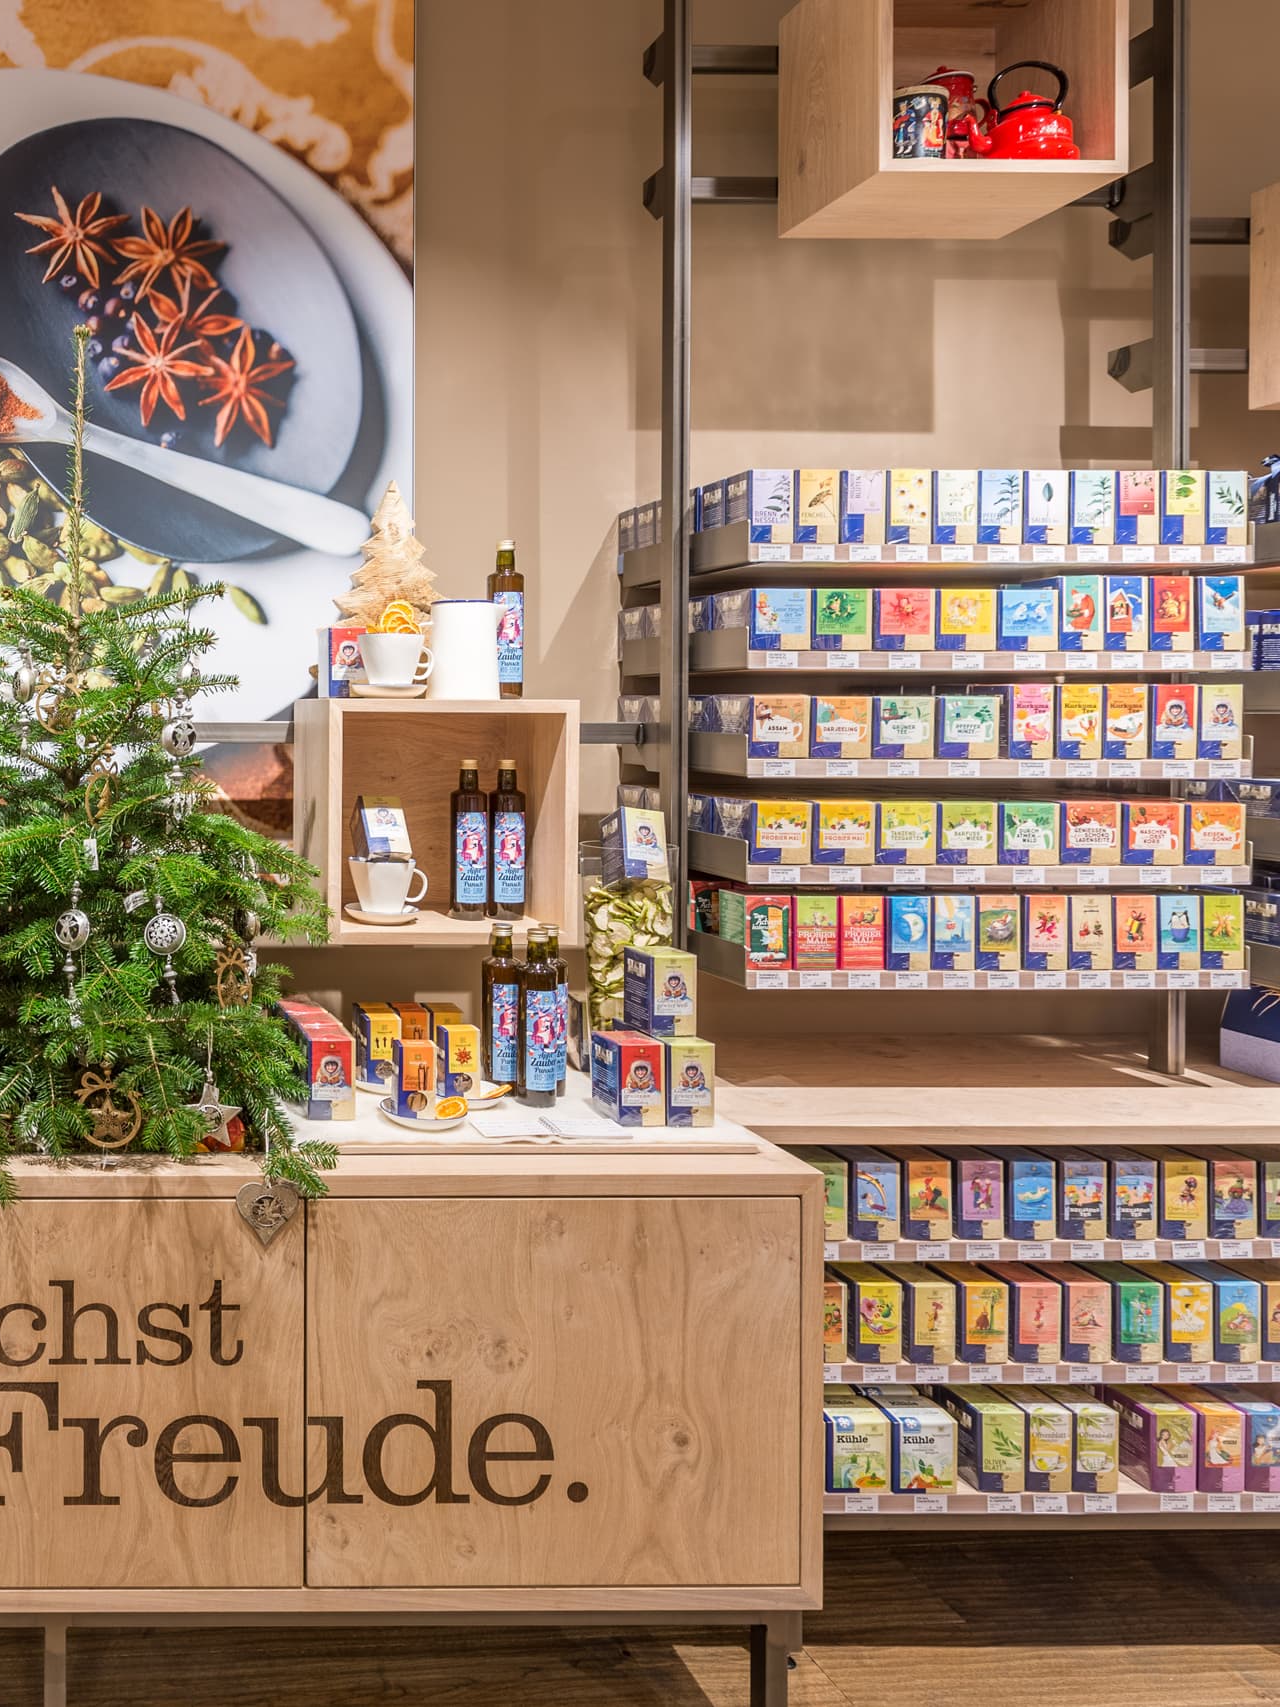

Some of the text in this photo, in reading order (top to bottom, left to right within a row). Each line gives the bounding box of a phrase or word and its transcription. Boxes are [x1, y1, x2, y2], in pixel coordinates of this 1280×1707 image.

[460, 872, 485, 880] Zauber
[498, 872, 523, 880] Zauber
[530, 1057, 556, 1066] Zauber
[836, 1435, 868, 1443] Kühle
[903, 1436, 935, 1444] Kühle
